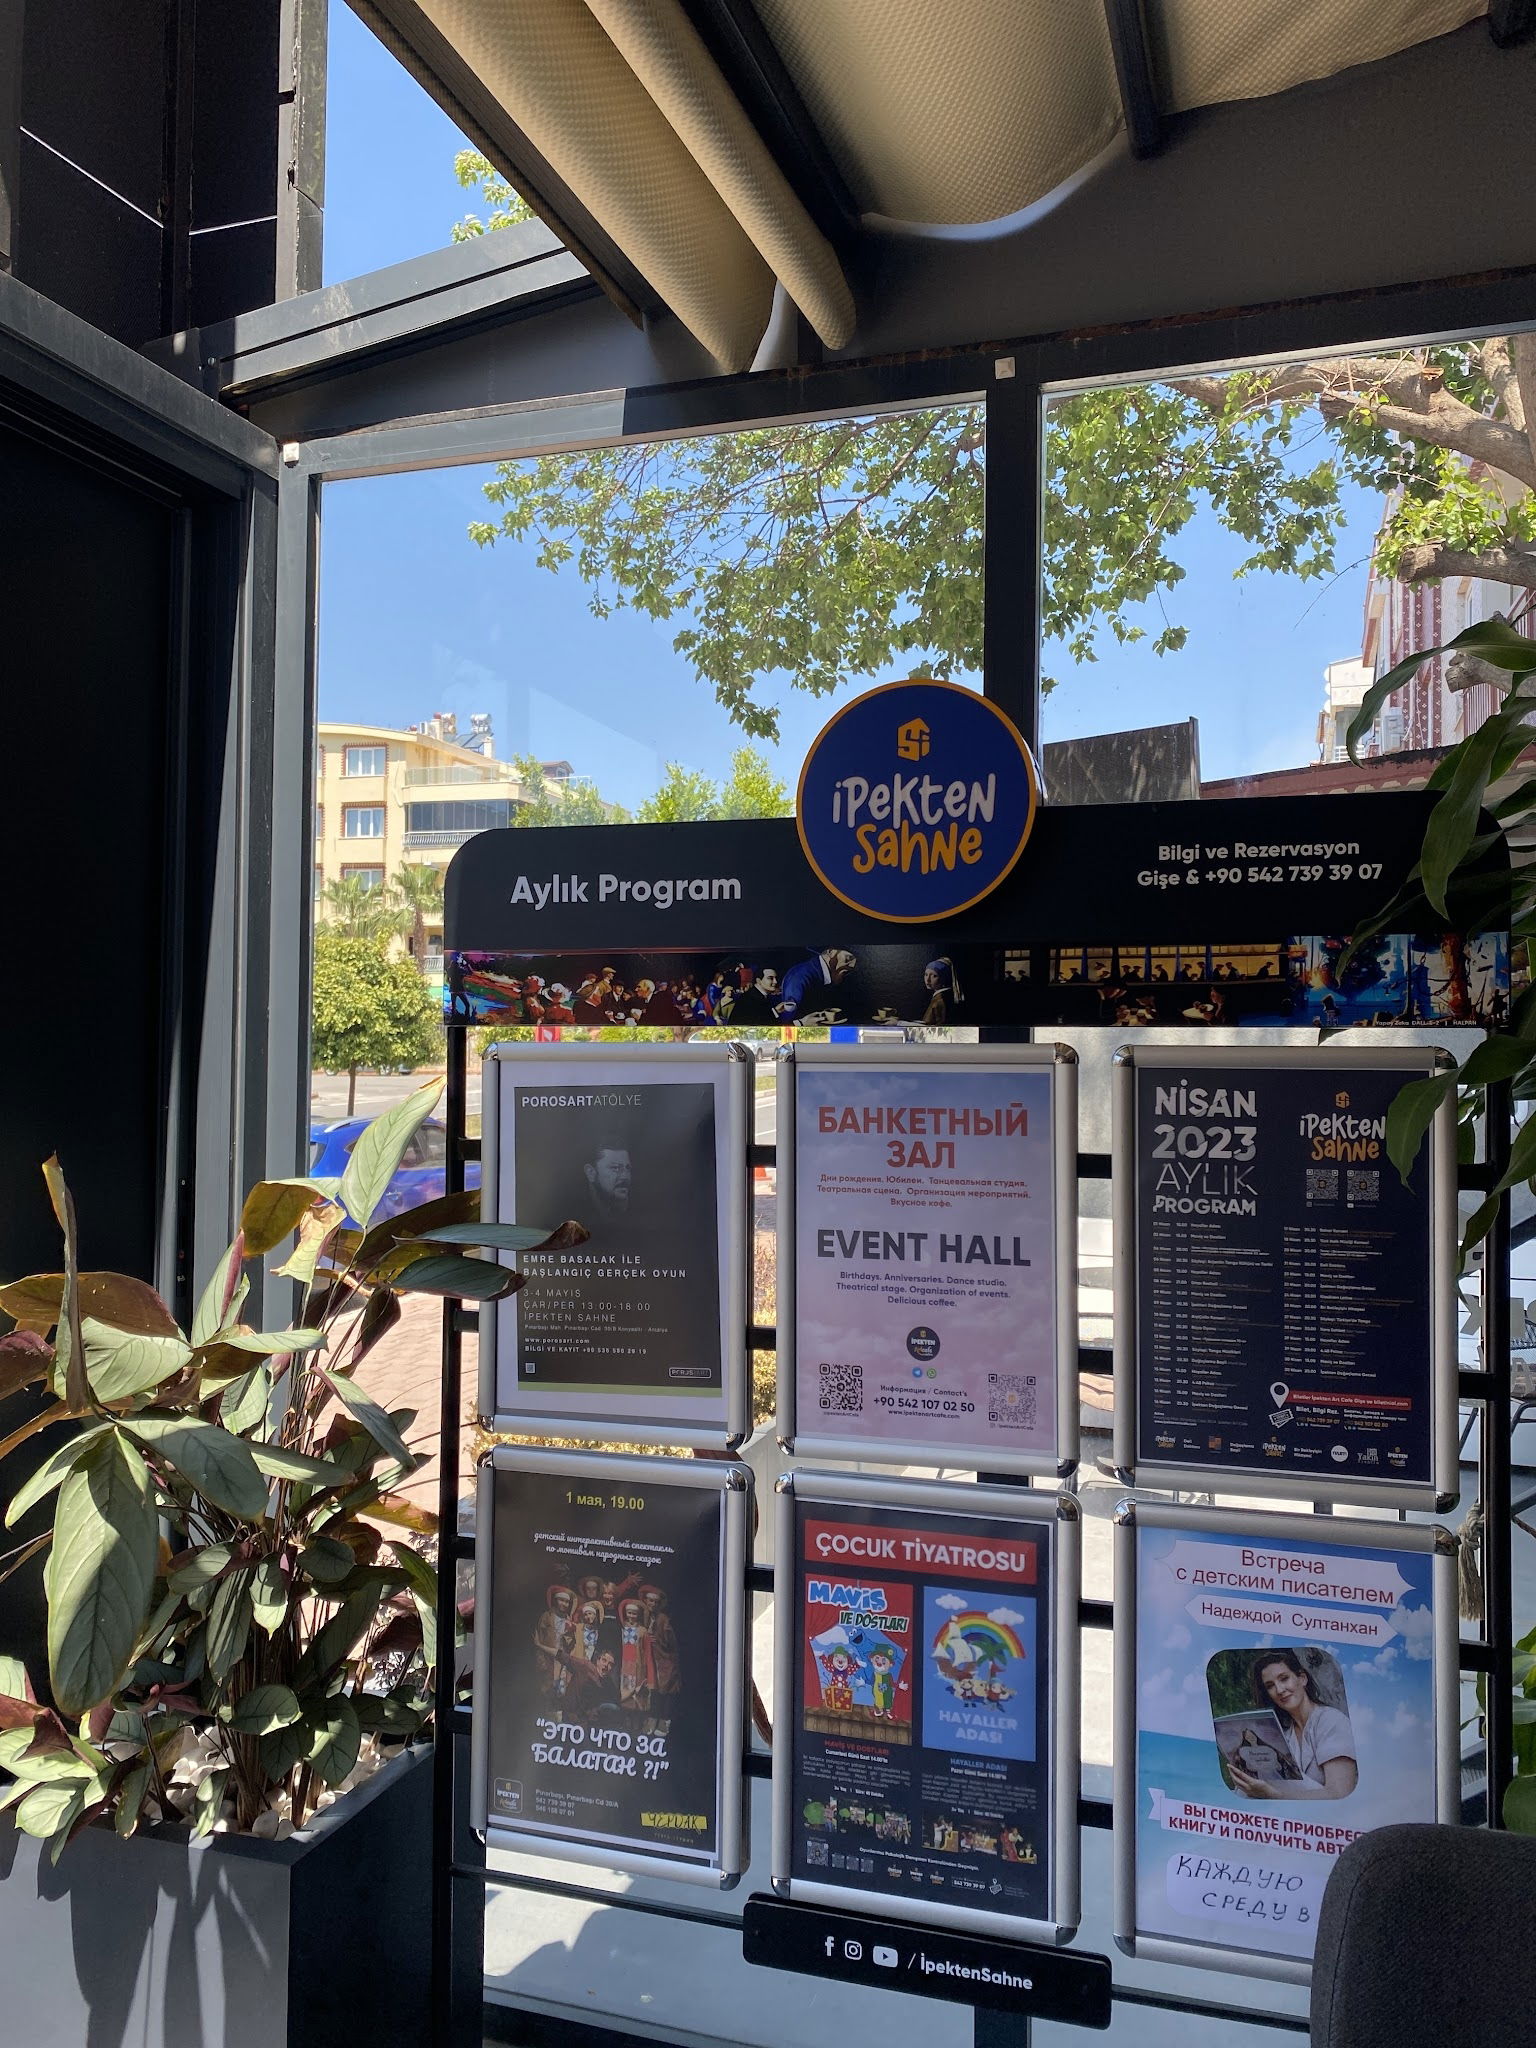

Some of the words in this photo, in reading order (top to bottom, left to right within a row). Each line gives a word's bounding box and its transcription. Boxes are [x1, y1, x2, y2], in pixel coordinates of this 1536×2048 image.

[1158, 843, 1200, 865] Bilgi
[1205, 846, 1228, 859] ve
[1235, 841, 1360, 861] Rezervasyon
[1136, 869, 1181, 890] Gişe
[1185, 868, 1200, 885] &
[1205, 867, 1242, 884] +90
[1247, 866, 1284, 883] 542
[1288, 865, 1322, 882] 739
[1329, 864, 1353, 880] 39
[1359, 863, 1382, 880] 07
[511, 873, 588, 910] Aylık
[599, 873, 742, 909] Program
[1154, 1079, 1257, 1118] NİSAN
[819, 1102, 1028, 1137] БАНКЕТНЫЙ
[1152, 1123, 1257, 1162] 2023
[886, 1140, 955, 1169] ЗАЛ
[820, 1173, 837, 1184] Дни
[839, 1174, 884, 1185] рождения.
[929, 1177, 991, 1187] Танцевальная
[993, 1179, 1028, 1188] студия.
[1155, 1161, 1258, 1196] AYLIK
[817, 1185, 871, 1195] Театральная
[873, 1187, 902, 1196] сцена.
[906, 1187, 966, 1198] Организация
[890, 1198, 927, 1208] Вкусное
[928, 1199, 953, 1208] кофе.
[1153, 1195, 1256, 1217] PROGRAM
[817, 1229, 928, 1261] EVENT
[940, 1233, 1031, 1266] HALL
[523, 1255, 554, 1263] EMRE
[560, 1255, 616, 1264] BASALAK
[621, 1254, 641, 1264] İLE
[523, 1268, 591, 1278] BAŞLANGIÇ
[597, 1269, 646, 1279] GERÇEK
[653, 1270, 686, 1278] OYUN
[840, 1272, 882, 1281] Birthdays.
[884, 1273, 945, 1284] Anniversaries.
[947, 1276, 976, 1286] Dance
[977, 1277, 1007, 1287] studio.
[523, 1289, 540, 1297] 3-4
[546, 1289, 581, 1298] MAYIS
[836, 1282, 879, 1292] Theatrical
[881, 1285, 907, 1294] stage.
[909, 1285, 966, 1297] Organization
[968, 1288, 978, 1296] of
[979, 1290, 1011, 1298] events.
[887, 1295, 926, 1306] Delicious
[928, 1297, 957, 1307] coffee.
[523, 1301, 575, 1311] ÇAR/PER
[524, 1311, 572, 1321] İPEKTEN
[578, 1313, 616, 1322] SAHNE
[525, 1344, 544, 1352] BİLGİ
[880, 1384, 926, 1395] Информация
[933, 1388, 967, 1397] Contact's
[873, 1396, 895, 1407] +90
[898, 1397, 919, 1409] 542
[921, 1399, 939, 1410] 107
[941, 1401, 957, 1411] 02
[960, 1402, 975, 1413] 50
[566, 1491, 573, 1504] 1
[577, 1494, 606, 1508] мая,
[610, 1495, 645, 1511] 19.00
[534, 1532, 566, 1543] детский
[566, 1535, 630, 1549] интерактивный
[631, 1541, 675, 1554] спектакль
[816, 1532, 897, 1559] ÇOCUK
[902, 1537, 1026, 1573] TİYATROSU
[546, 1545, 556, 1553] по
[556, 1544, 595, 1557] мотивам
[596, 1549, 635, 1564] народных
[636, 1555, 662, 1567] сказок
[1241, 1550, 1325, 1575] Встреча
[808, 1580, 888, 1612] MAVİŞ
[1176, 1567, 1187, 1580] с
[1192, 1567, 1275, 1591] детским
[1281, 1579, 1394, 1605] писателем
[839, 1611, 854, 1627] VE
[855, 1613, 909, 1633] DOSTLARI
[1201, 1602, 1282, 1625] Надеждой
[1291, 1613, 1378, 1636] Султанхан
[939, 1709, 1018, 1731] HAYALLER
[955, 1727, 1003, 1744] ADASI
[950, 1757, 984, 1769] HAYALLER
[985, 1762, 1007, 1772] ADASI
[1169, 1816, 1216, 1834] КНИГУ
[1220, 1826, 1230, 1838] И
[1234, 1828, 1312, 1851] ПОЛУЧИТЬ
[1183, 1803, 1206, 1819] ВЫ
[1210, 1808, 1279, 1831] СМОЖЕТЕ
[1283, 1820, 1366, 1842] ПРИОБРЕС
[1176, 1855, 1303, 1892] КАЖДУЮ
[1202, 1892, 1288, 1922] СРЕДУ
